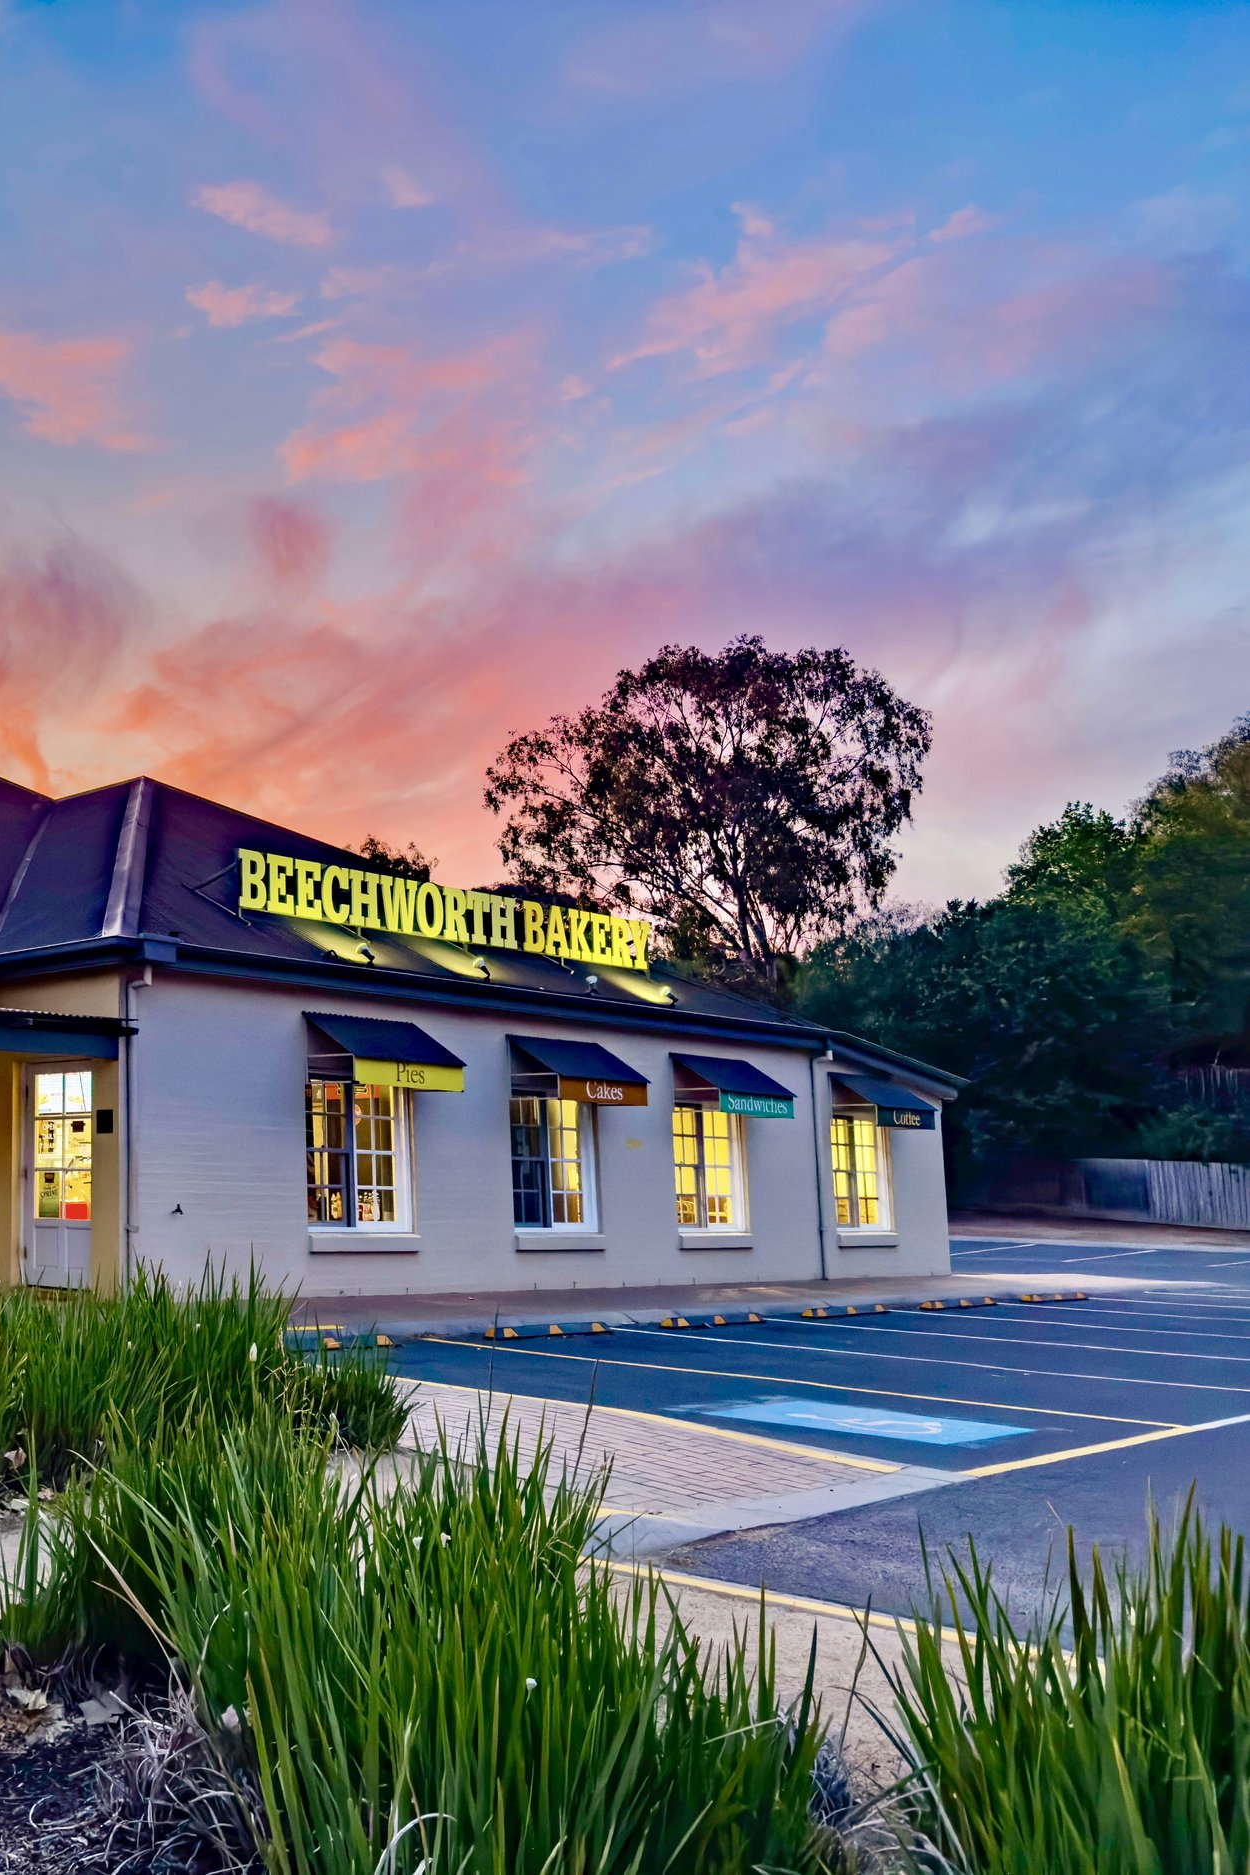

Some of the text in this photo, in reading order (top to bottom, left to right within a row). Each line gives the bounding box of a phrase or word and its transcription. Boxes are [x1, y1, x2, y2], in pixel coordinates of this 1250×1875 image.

[238, 848, 652, 969] BEECHWORTH BAKERY
[396, 1062, 425, 1084] Pies
[586, 1080, 623, 1100] Cakes
[728, 1092, 788, 1114] Sandwiches
[893, 1110, 921, 1126] Coffee
